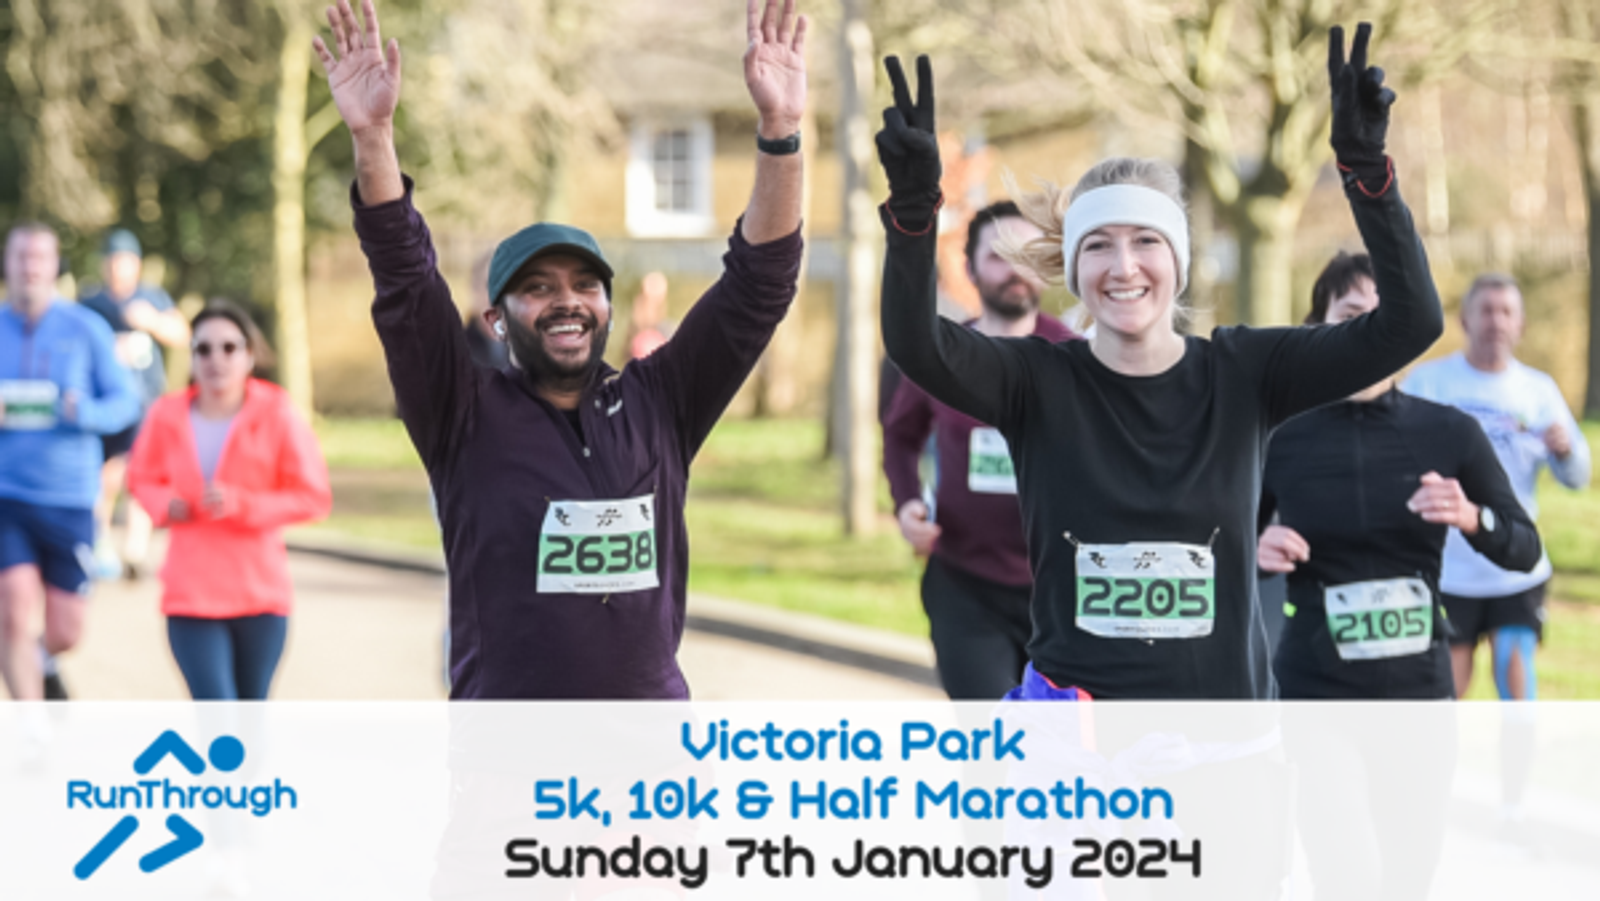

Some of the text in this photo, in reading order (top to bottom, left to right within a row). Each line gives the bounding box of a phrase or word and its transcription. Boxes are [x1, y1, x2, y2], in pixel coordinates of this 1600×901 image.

[542, 530, 653, 574] 2638
[1082, 577, 1209, 617] 2205
[1335, 606, 1426, 643] 2105
